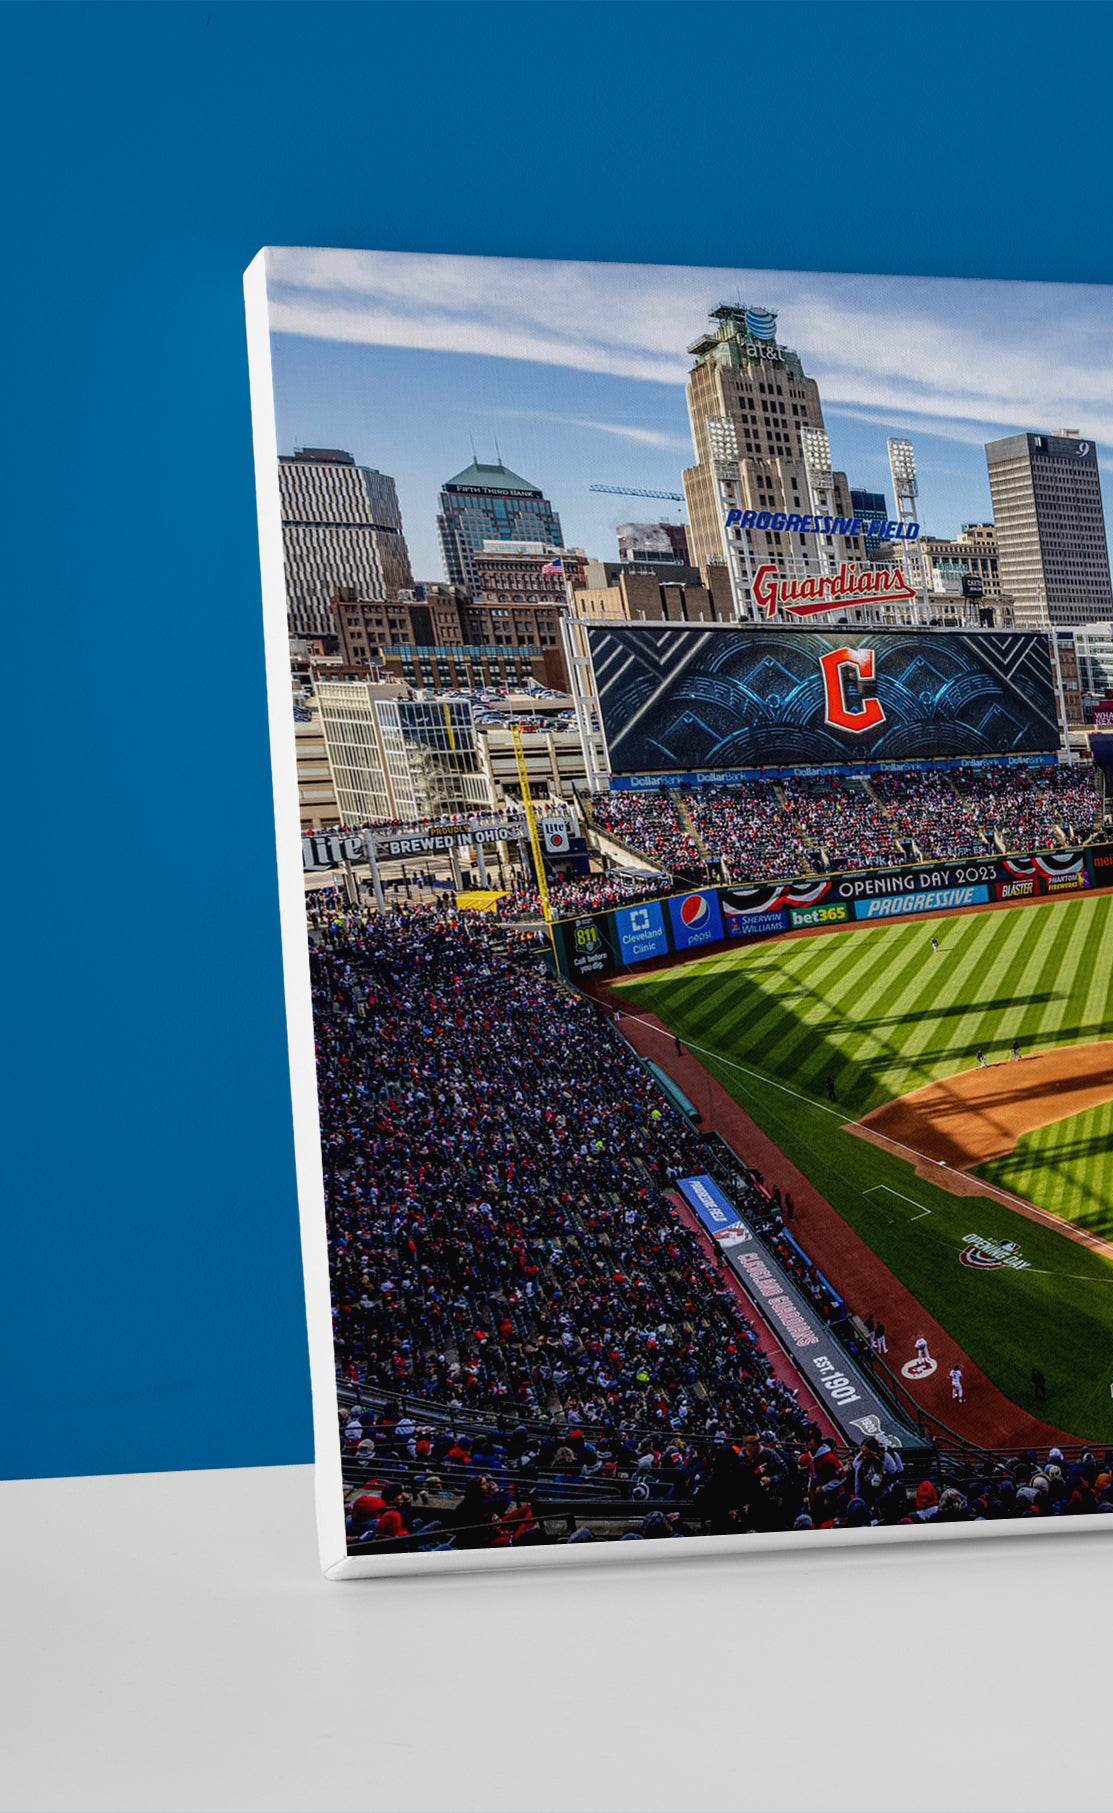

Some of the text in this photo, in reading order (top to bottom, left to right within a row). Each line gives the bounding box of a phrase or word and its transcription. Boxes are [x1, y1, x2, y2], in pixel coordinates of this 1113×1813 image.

[746, 341, 785, 362] at&t
[1075, 442, 1090, 458] 9
[482, 488, 509, 496] THIRD
[510, 490, 534, 498] BANK
[725, 508, 920, 540] PROGRESSIVE FIELD
[753, 561, 917, 619] Guardians
[431, 824, 469, 836] PROUDLY
[545, 824, 565, 835] Lite
[390, 828, 508, 855] BREWED IN OHIO
[839, 865, 997, 897] OPENING DAY 2023
[1048, 874, 1078, 885] PHANTOM
[1001, 882, 1034, 898] BLASTER
[867, 887, 975, 917] PROGRESSIVE
[742, 913, 782, 925] SHERWIN
[792, 906, 846, 926] bet365
[576, 927, 597, 946] 811
[622, 927, 664, 945] Cleveland
[742, 921, 784, 934] WILLIAMS
[687, 930, 712, 946] pepsi
[587, 952, 608, 963] before
[632, 944, 657, 954] Clinic
[961, 1232, 1032, 1271] OPENING DAY
[736, 1251, 819, 1347] CLEVELAND GUARDIANS
[812, 1355, 862, 1407] EST. 1901
